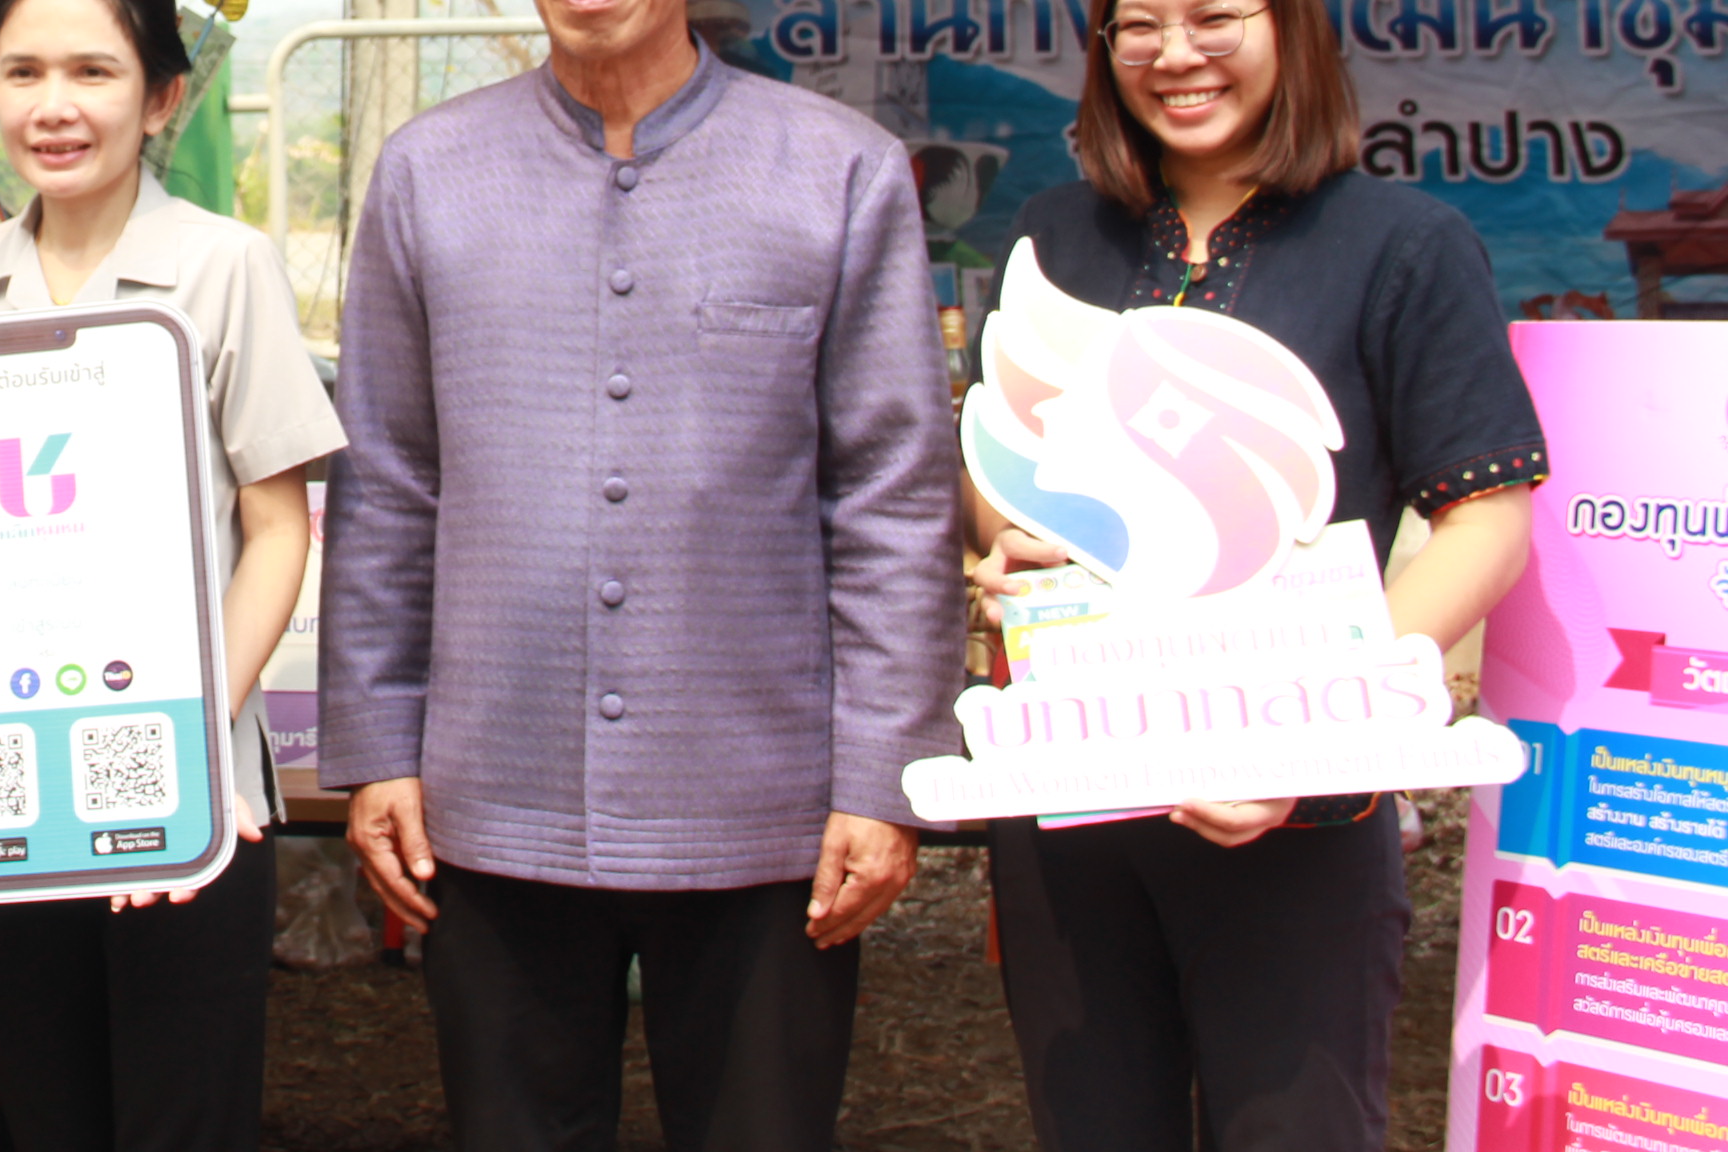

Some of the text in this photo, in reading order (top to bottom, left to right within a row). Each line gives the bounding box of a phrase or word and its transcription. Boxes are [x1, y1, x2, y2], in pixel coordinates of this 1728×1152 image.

[1038, 605, 1080, 622] NEW
[981, 657, 1429, 747] บทบาทสตรี
[8, 845, 27, 858] play
[116, 837, 160, 851] App Store
[1496, 906, 1534, 944] 02
[1579, 910, 1728, 959] เป็นแหล่งเงินทุนเพื่อ
[1485, 1068, 1525, 1108] 03
